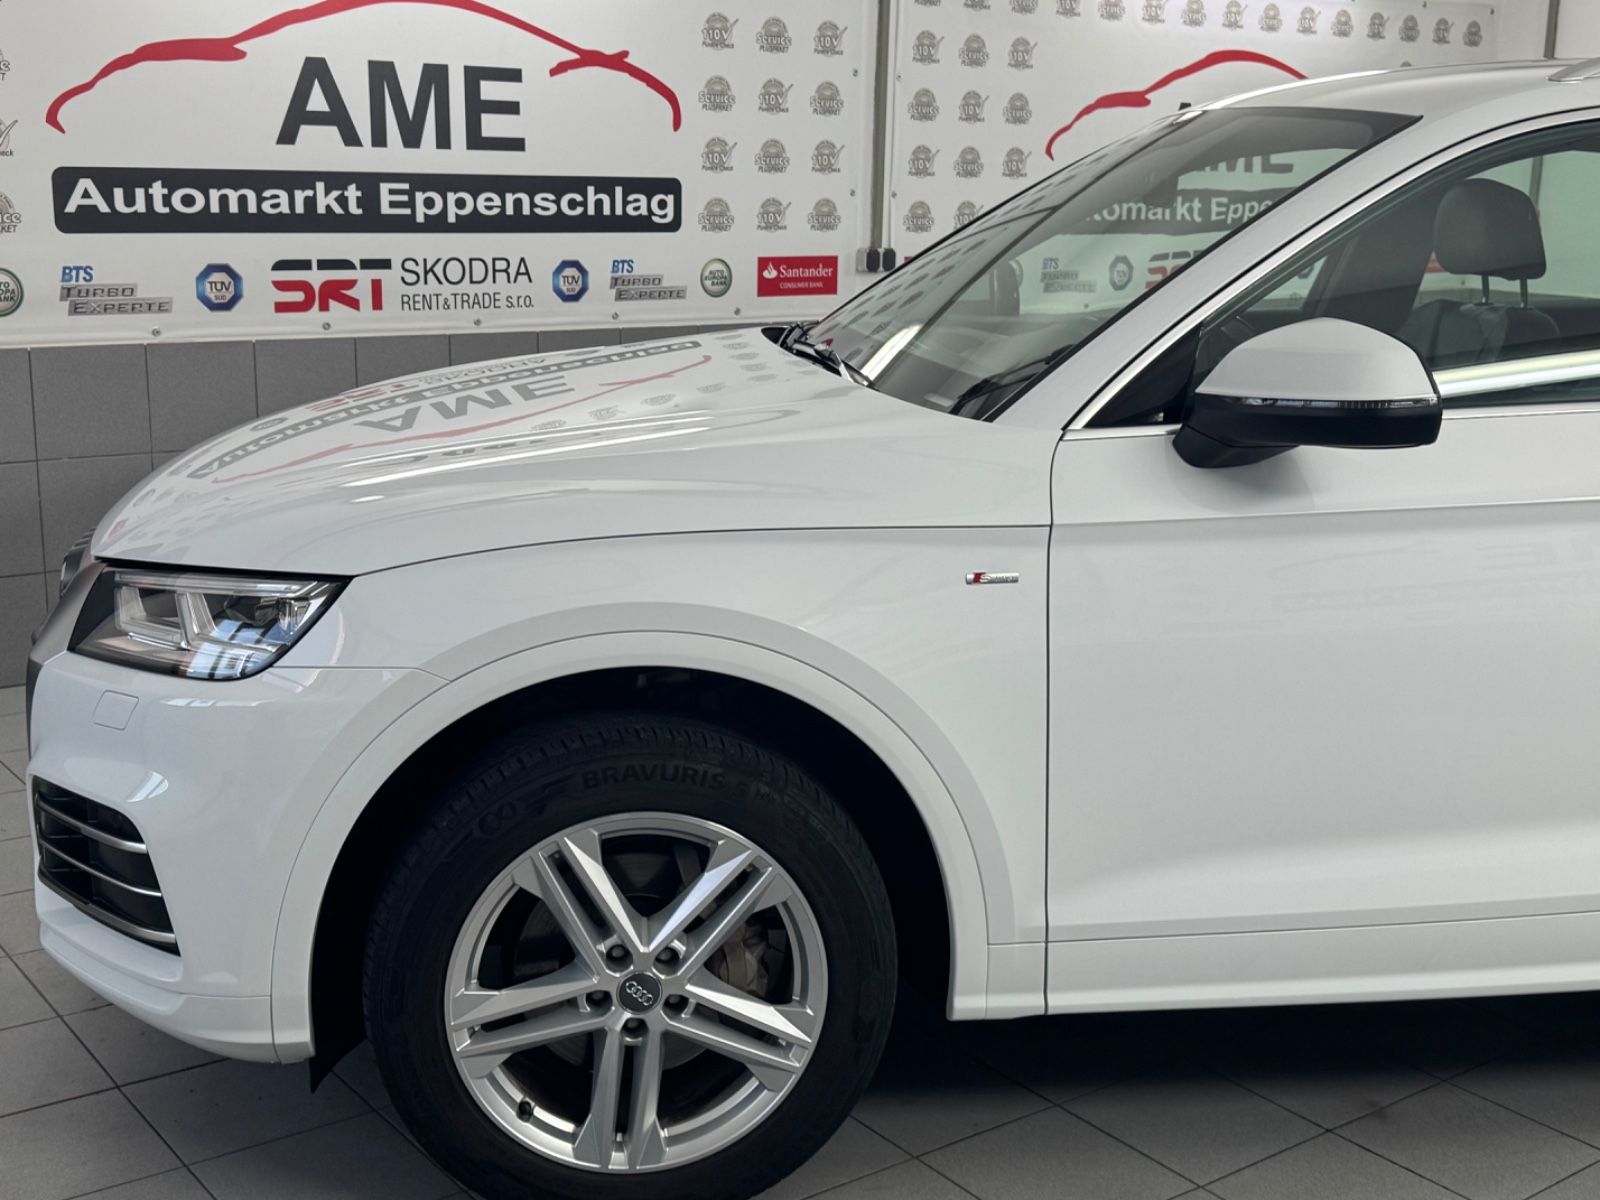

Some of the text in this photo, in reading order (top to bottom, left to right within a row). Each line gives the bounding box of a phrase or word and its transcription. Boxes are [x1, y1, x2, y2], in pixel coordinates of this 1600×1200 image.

[275, 55, 527, 152] AME
[63, 176, 676, 225] Automarkt Eppenschlag
[61, 265, 94, 283] BTS
[400, 257, 534, 287] SKODRA
[611, 259, 634, 274] BTS
[779, 263, 834, 279] Santander
[400, 292, 501, 312] RENT&TRADE
[581, 762, 727, 790] BRAVURIS
